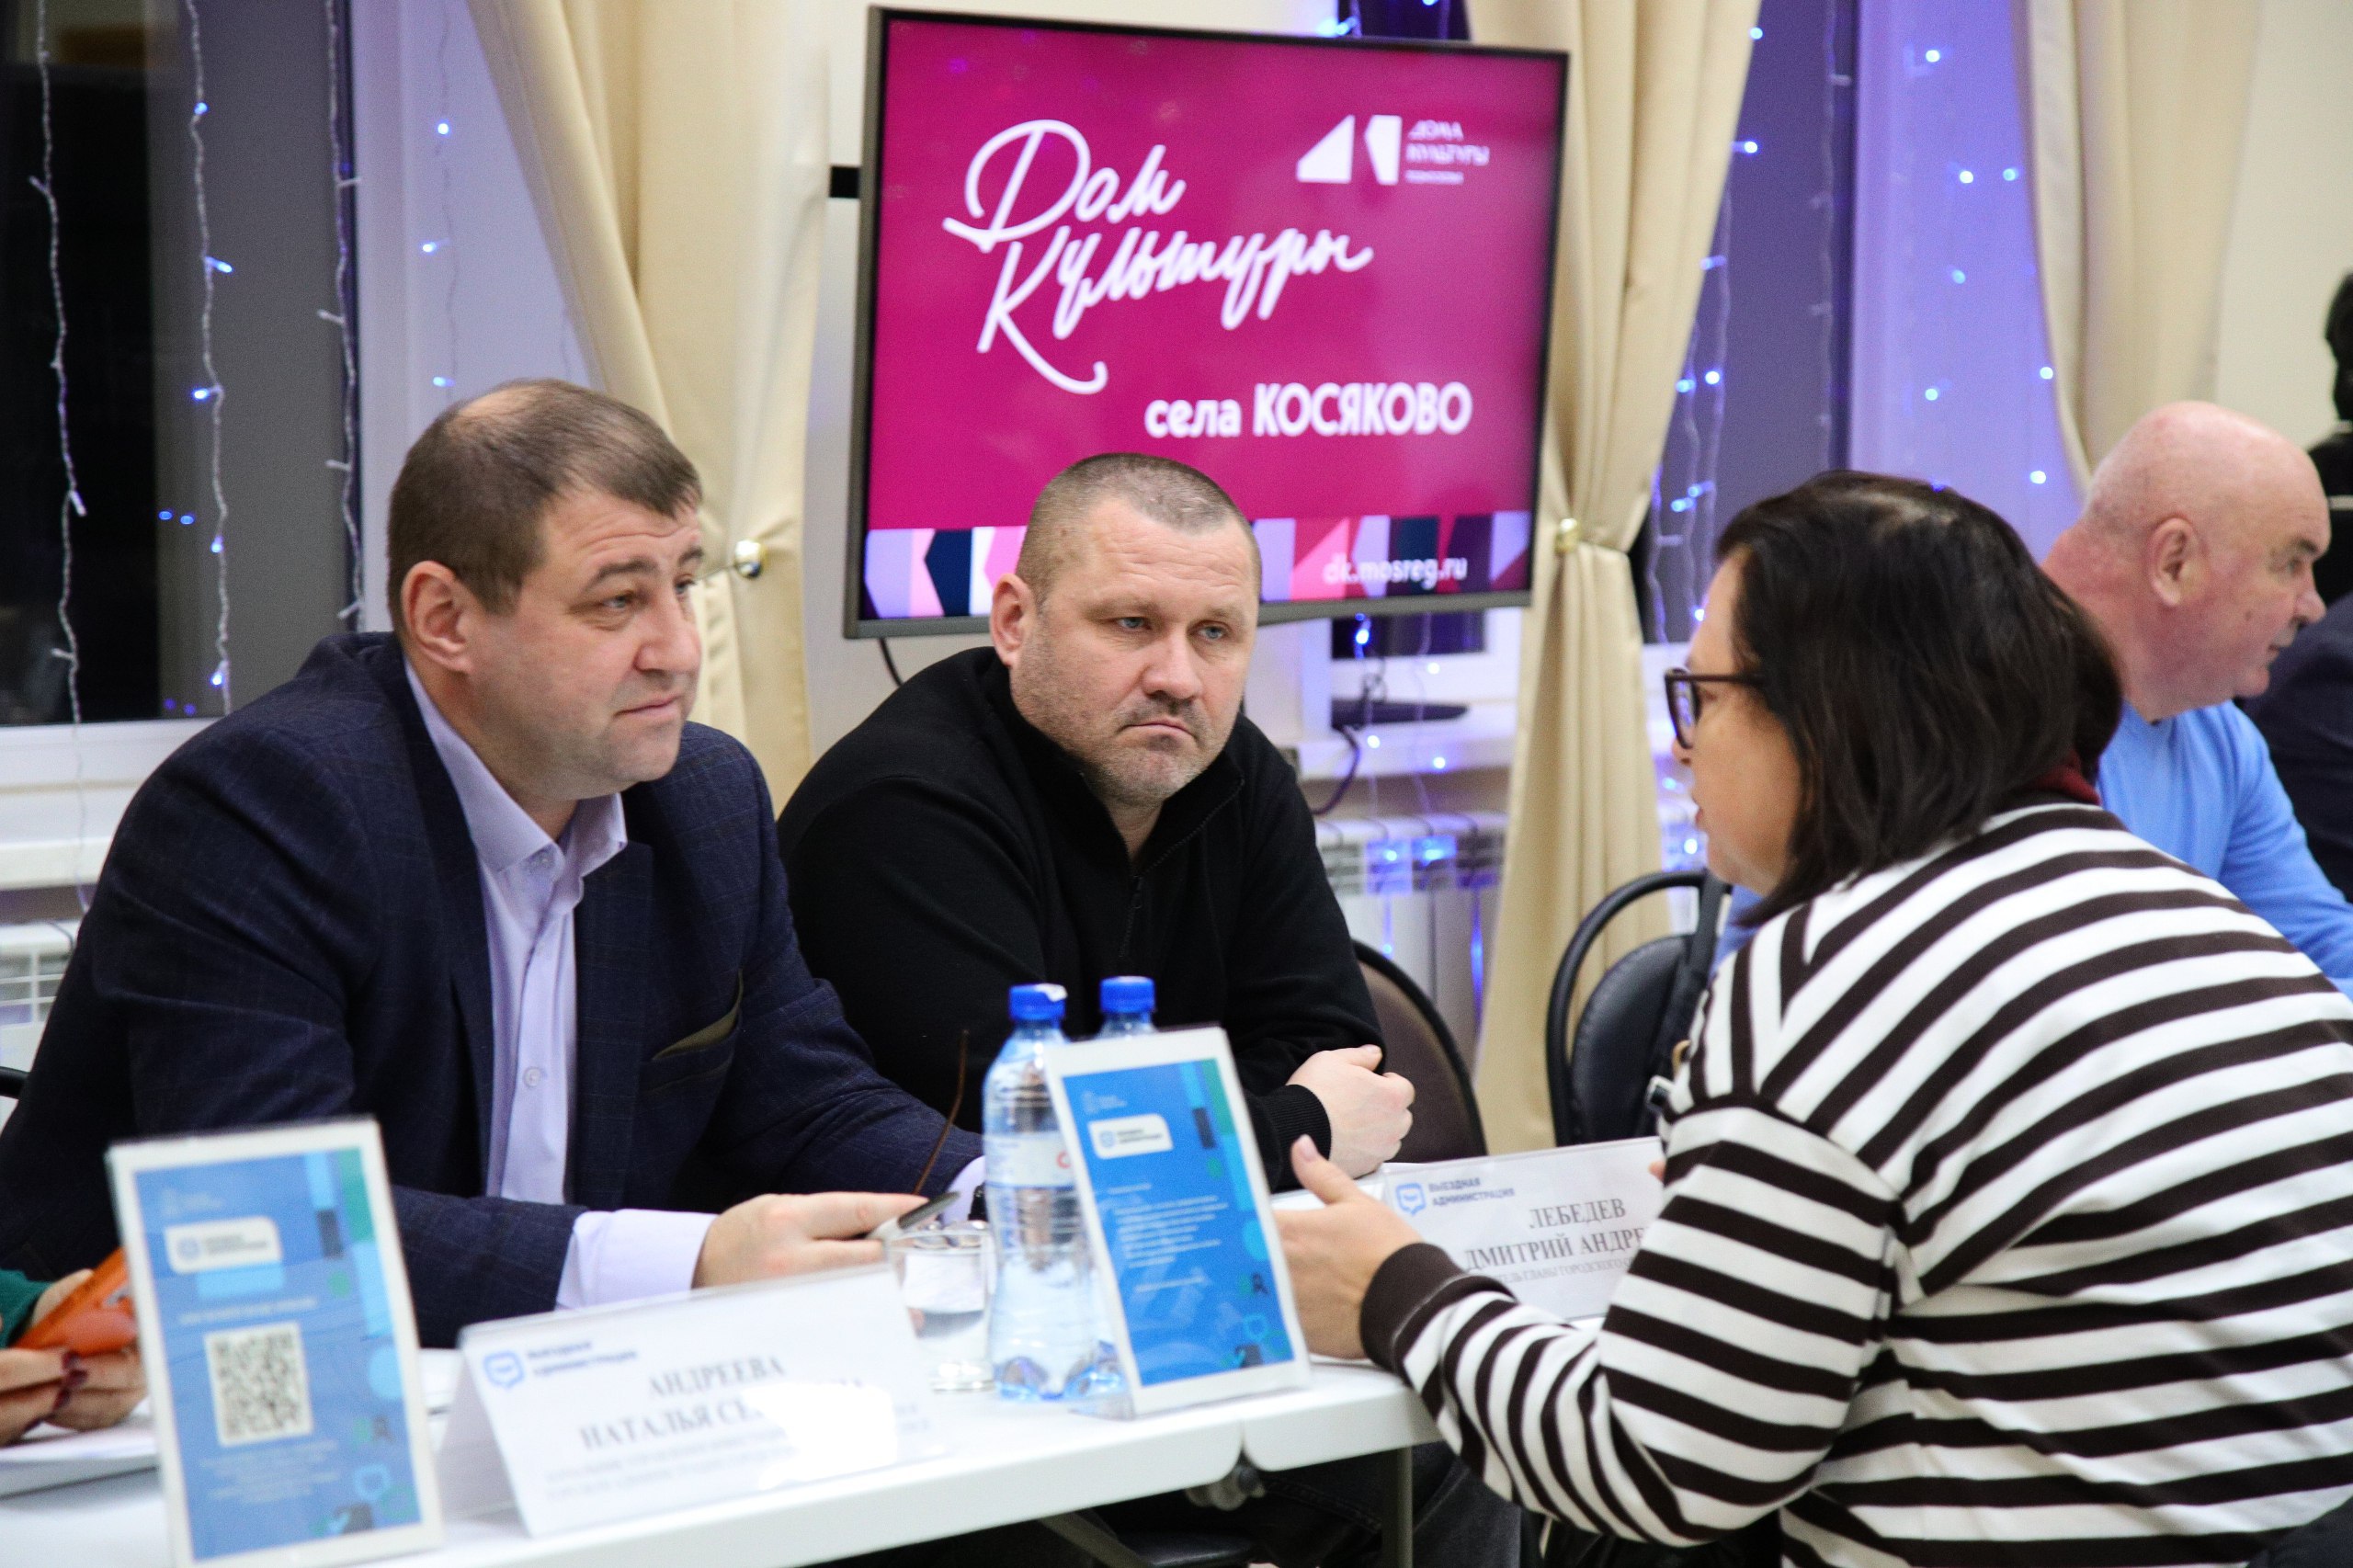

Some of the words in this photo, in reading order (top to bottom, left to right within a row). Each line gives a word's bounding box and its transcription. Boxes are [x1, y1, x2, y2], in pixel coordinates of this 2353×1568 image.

[942, 119, 1186, 252] Дом
[977, 225, 1373, 394] Культуры
[1144, 399, 1242, 438] села
[1252, 381, 1472, 437] КОСЯКОВО
[1322, 554, 1468, 591] dk.mosreg.ru
[1529, 1198, 1626, 1230] ЛЕБЕДЕВ
[1465, 1232, 1574, 1273] ДМИТРИЙ
[580, 1405, 714, 1450] НАТАЛЬЯ
